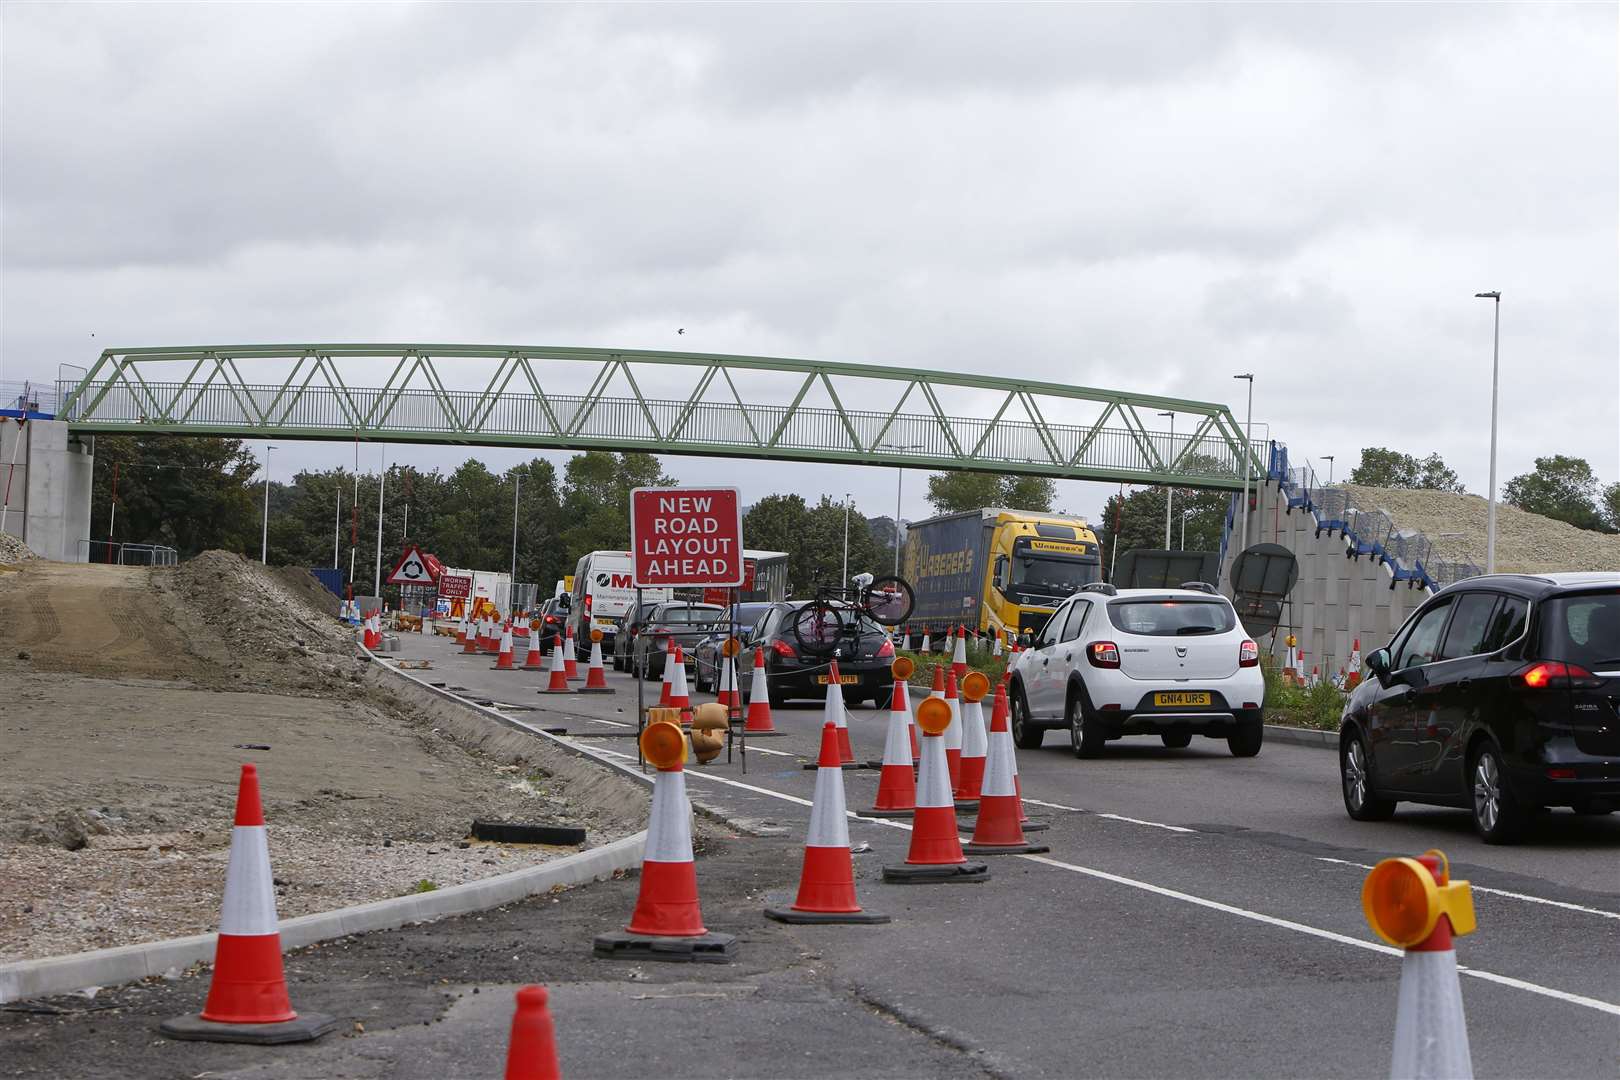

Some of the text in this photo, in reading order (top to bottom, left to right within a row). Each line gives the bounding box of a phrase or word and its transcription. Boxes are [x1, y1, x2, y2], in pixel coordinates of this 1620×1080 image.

[660, 497, 711, 513] NEW
[654, 518, 718, 534] ROAD
[644, 538, 731, 555] LAYOUT
[648, 559, 727, 576] AHEAD
[1160, 694, 1205, 704] GN14 URS
